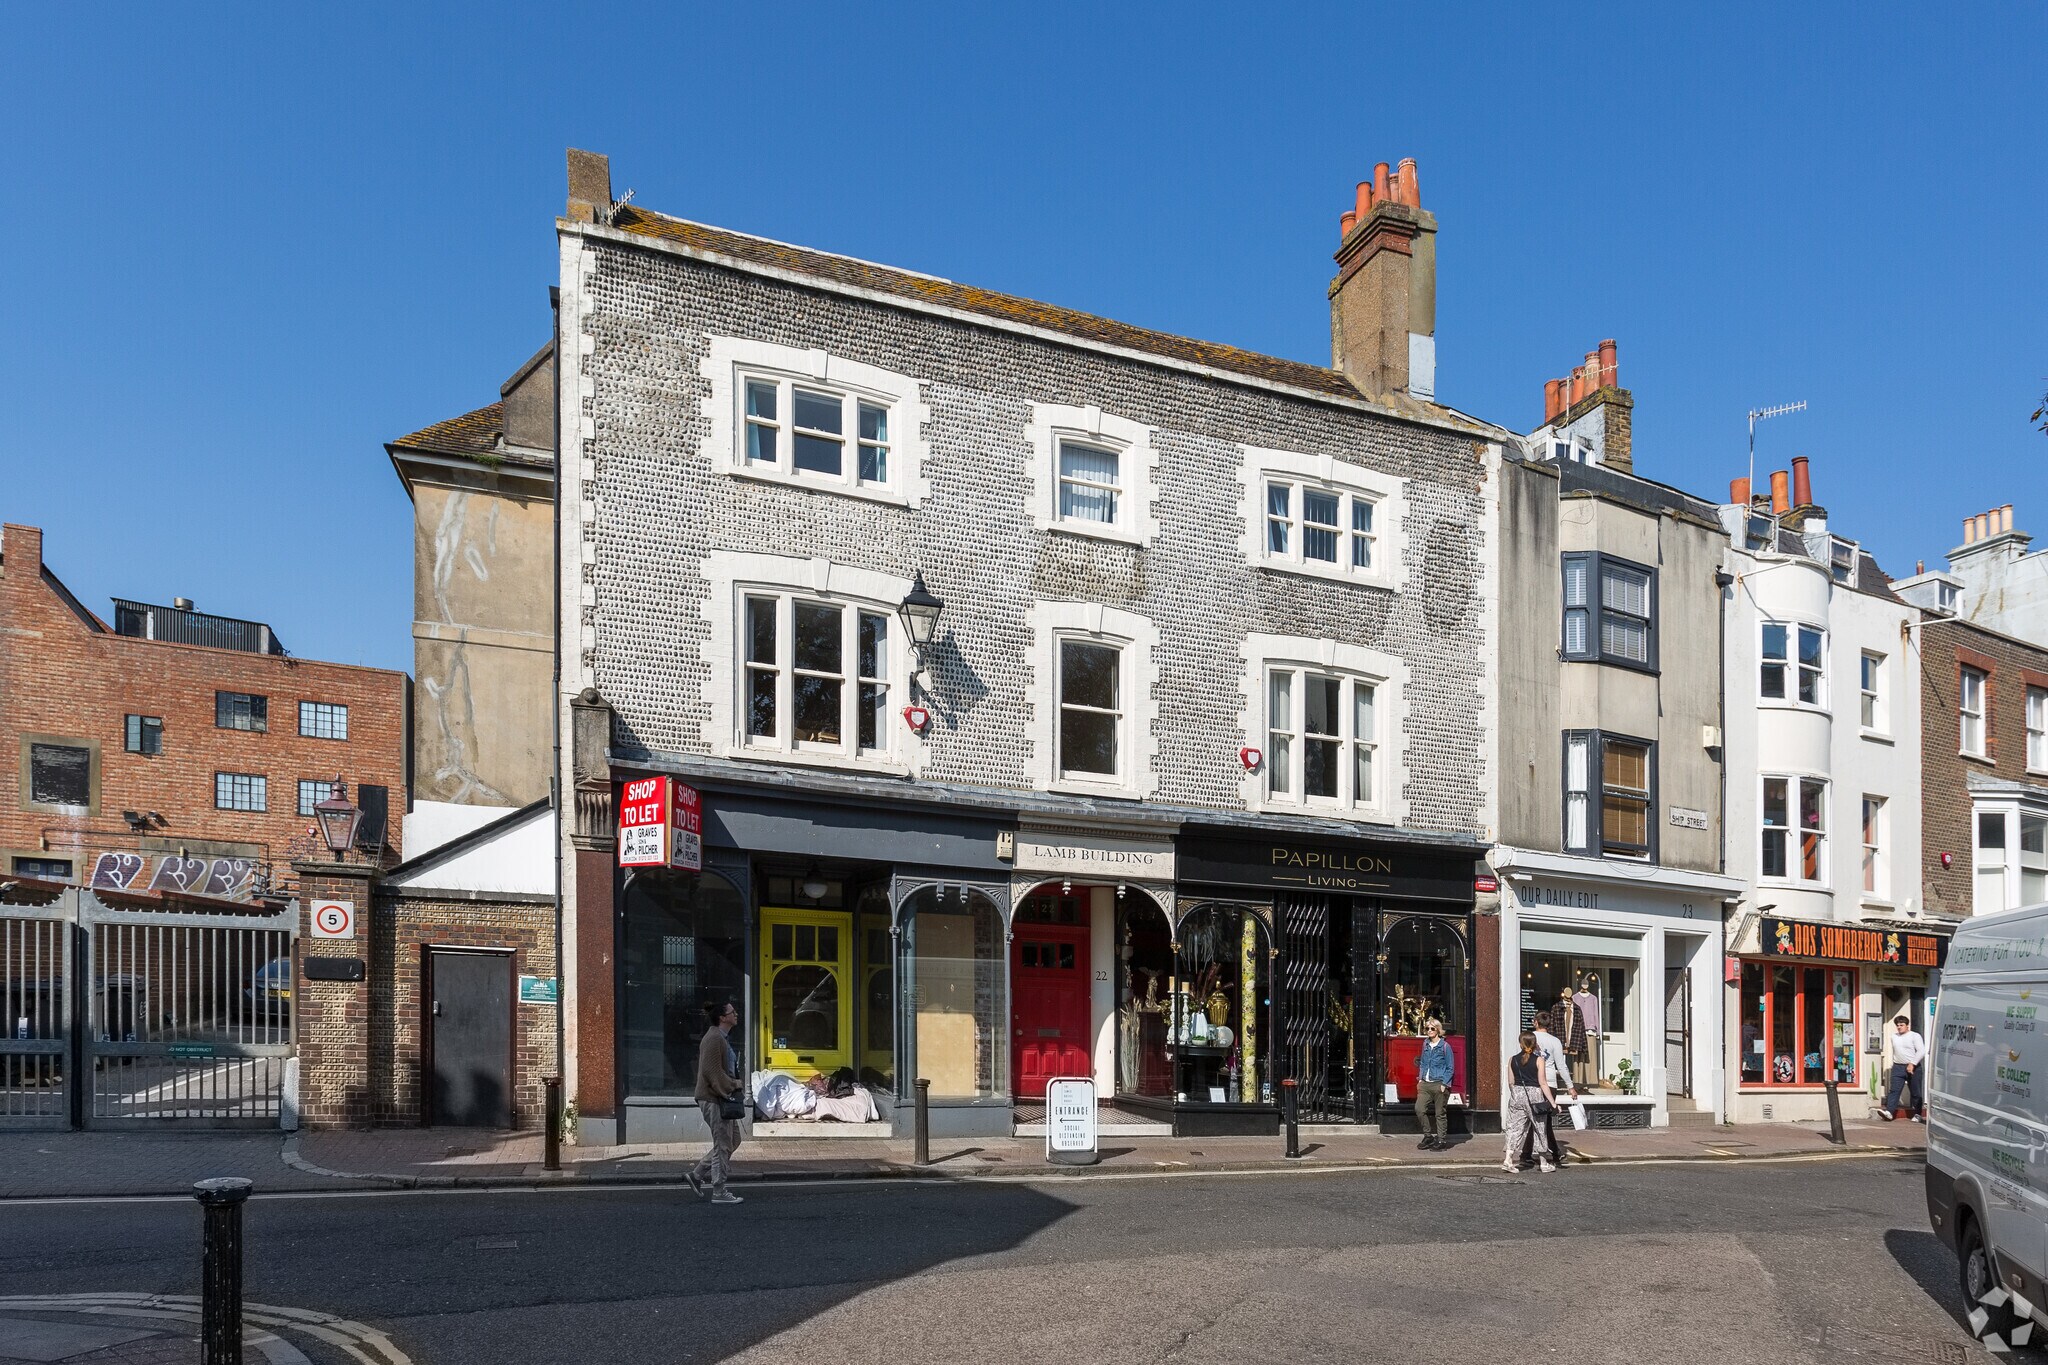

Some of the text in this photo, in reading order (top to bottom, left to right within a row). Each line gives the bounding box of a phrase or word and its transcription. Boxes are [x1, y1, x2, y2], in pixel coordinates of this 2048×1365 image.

[628, 780, 656, 801] SHOP
[678, 785, 696, 807] SHOP
[624, 804, 658, 824] TO LET
[676, 808, 699, 831] TO LET
[1672, 815, 1705, 827] SHIP STREET
[638, 827, 657, 838] GRAVES
[638, 845, 658, 855] PILCHER
[1034, 846, 1153, 865] LAMB BUILDING
[1272, 848, 1391, 873] PAPILLON
[1308, 875, 1356, 888] LIVING
[1521, 886, 1598, 909] OUR DAILY EDIT
[1041, 904, 1055, 913] 22
[1682, 904, 1693, 919] 23
[328, 914, 337, 925] 5
[1794, 924, 1884, 962] DOS SOMBREROS
[1954, 945, 1989, 964] CATERING
[1992, 940, 2010, 960] FOR
[2014, 938, 2034, 958] YOU
[1096, 971, 1107, 980] 22
[2016, 1006, 2037, 1019] SUPPLY
[2006, 1068, 2031, 1084] COLLECT
[1056, 1107, 1088, 1115] ENTRANCE
[2000, 1151, 2025, 1173] RECYCLE
